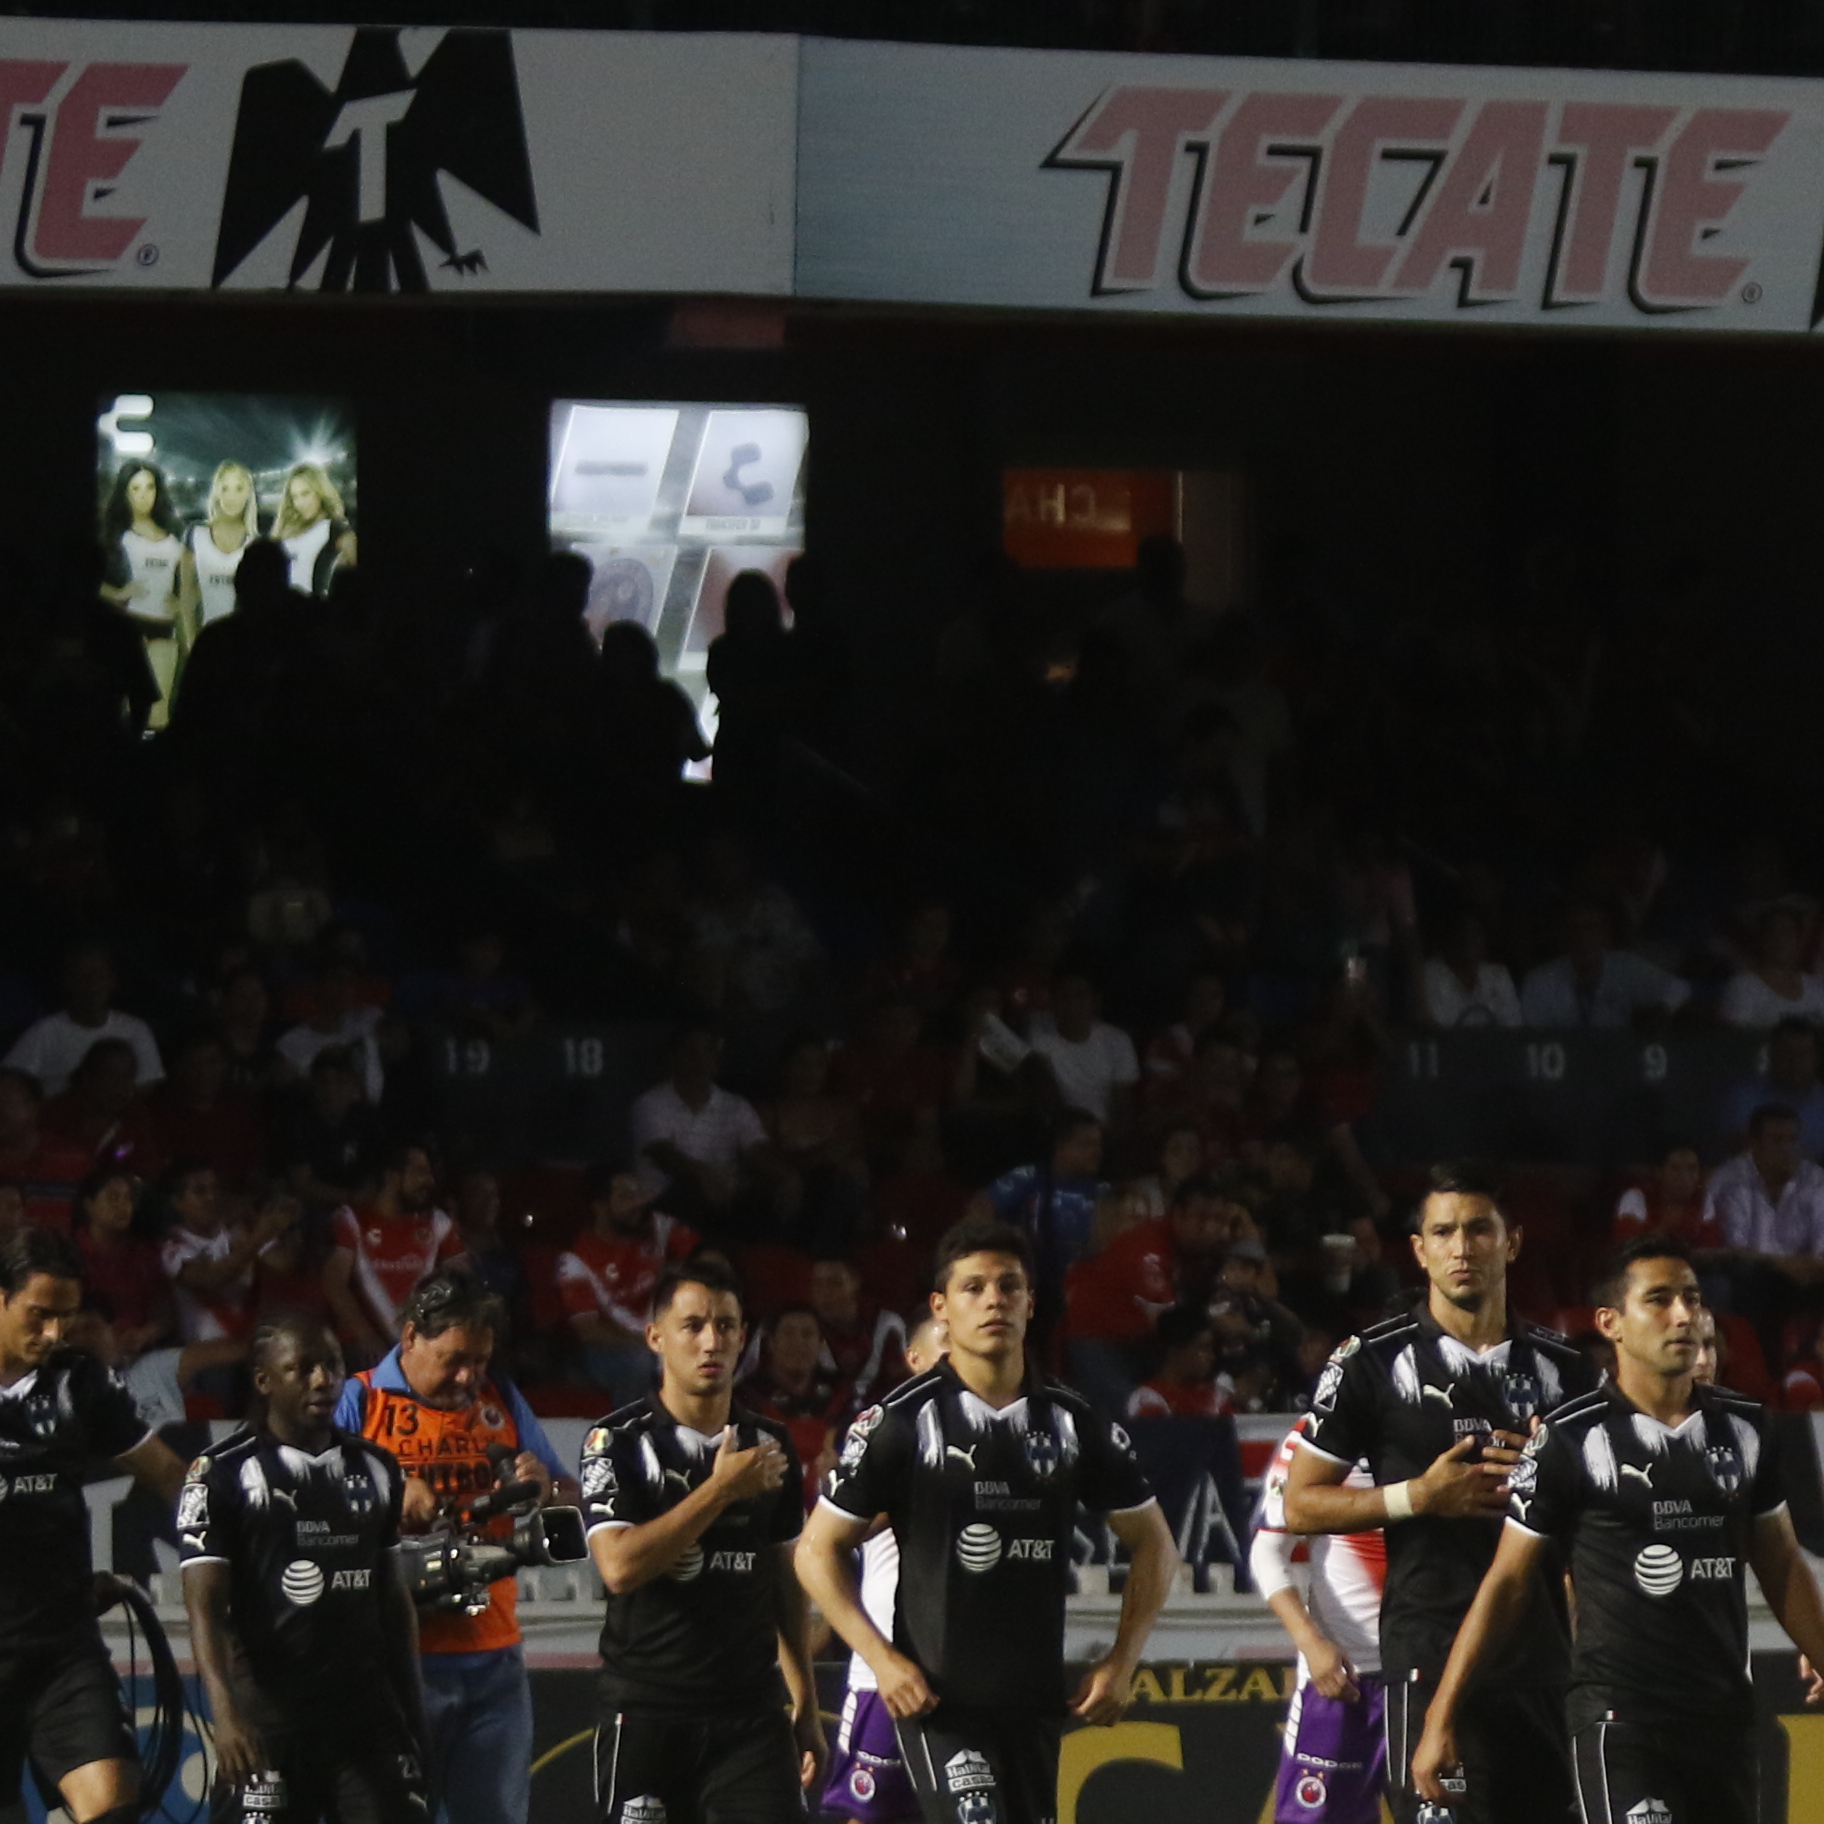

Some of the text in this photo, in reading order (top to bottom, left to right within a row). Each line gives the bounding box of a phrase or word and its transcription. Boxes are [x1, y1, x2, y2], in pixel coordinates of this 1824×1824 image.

[1040, 84, 1792, 316] TECATE
[562, 1035, 605, 1078] 18
[1525, 1042, 1566, 1080] 10
[384, 1403, 419, 1436] 13
[1453, 1418, 1493, 1434] BBVA
[13, 1473, 58, 1494] AT&T
[974, 1481, 1010, 1495] BBVA
[975, 1495, 1043, 1510] Bancomer
[1652, 1500, 1694, 1516] BBVA
[1653, 1514, 1726, 1531] Bancomer
[1007, 1538, 1055, 1559] AT&T
[710, 1551, 756, 1571] AT&T
[1690, 1557, 1737, 1581] AT&T
[331, 1568, 372, 1590] AT&T
